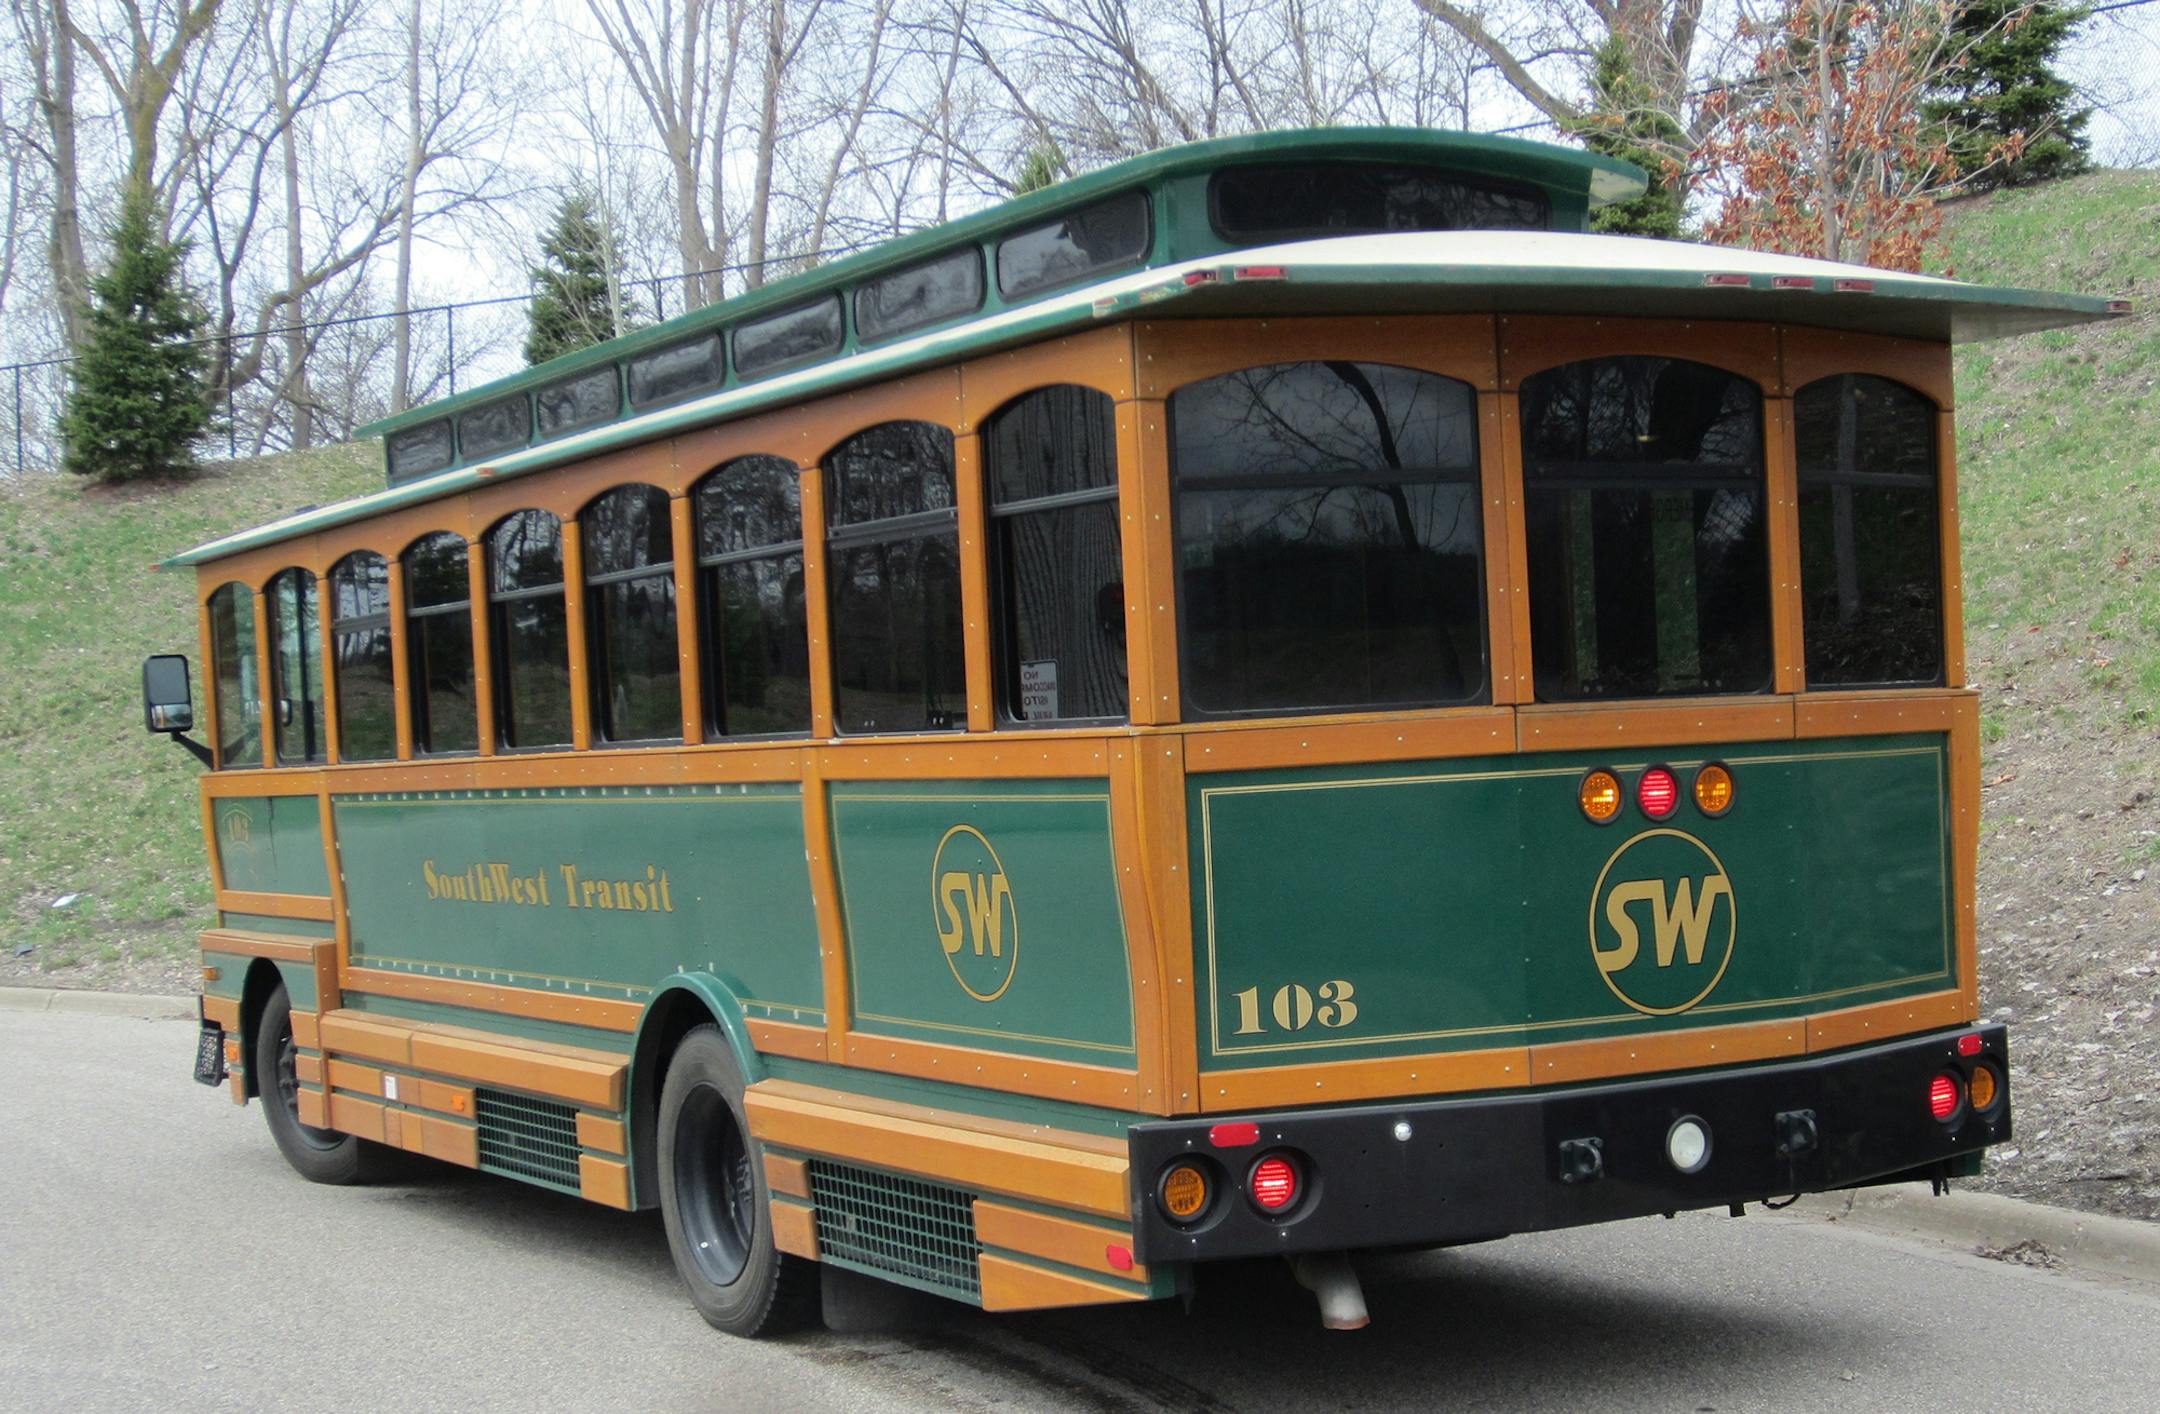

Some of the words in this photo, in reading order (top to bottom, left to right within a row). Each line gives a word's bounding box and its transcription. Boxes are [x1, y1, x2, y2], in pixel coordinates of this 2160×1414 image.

[423, 859, 550, 907] SouthWest
[559, 863, 674, 912] Transit
[941, 872, 1009, 957] SW
[1597, 874, 1730, 968] SW
[1231, 980, 1358, 1036] 103
